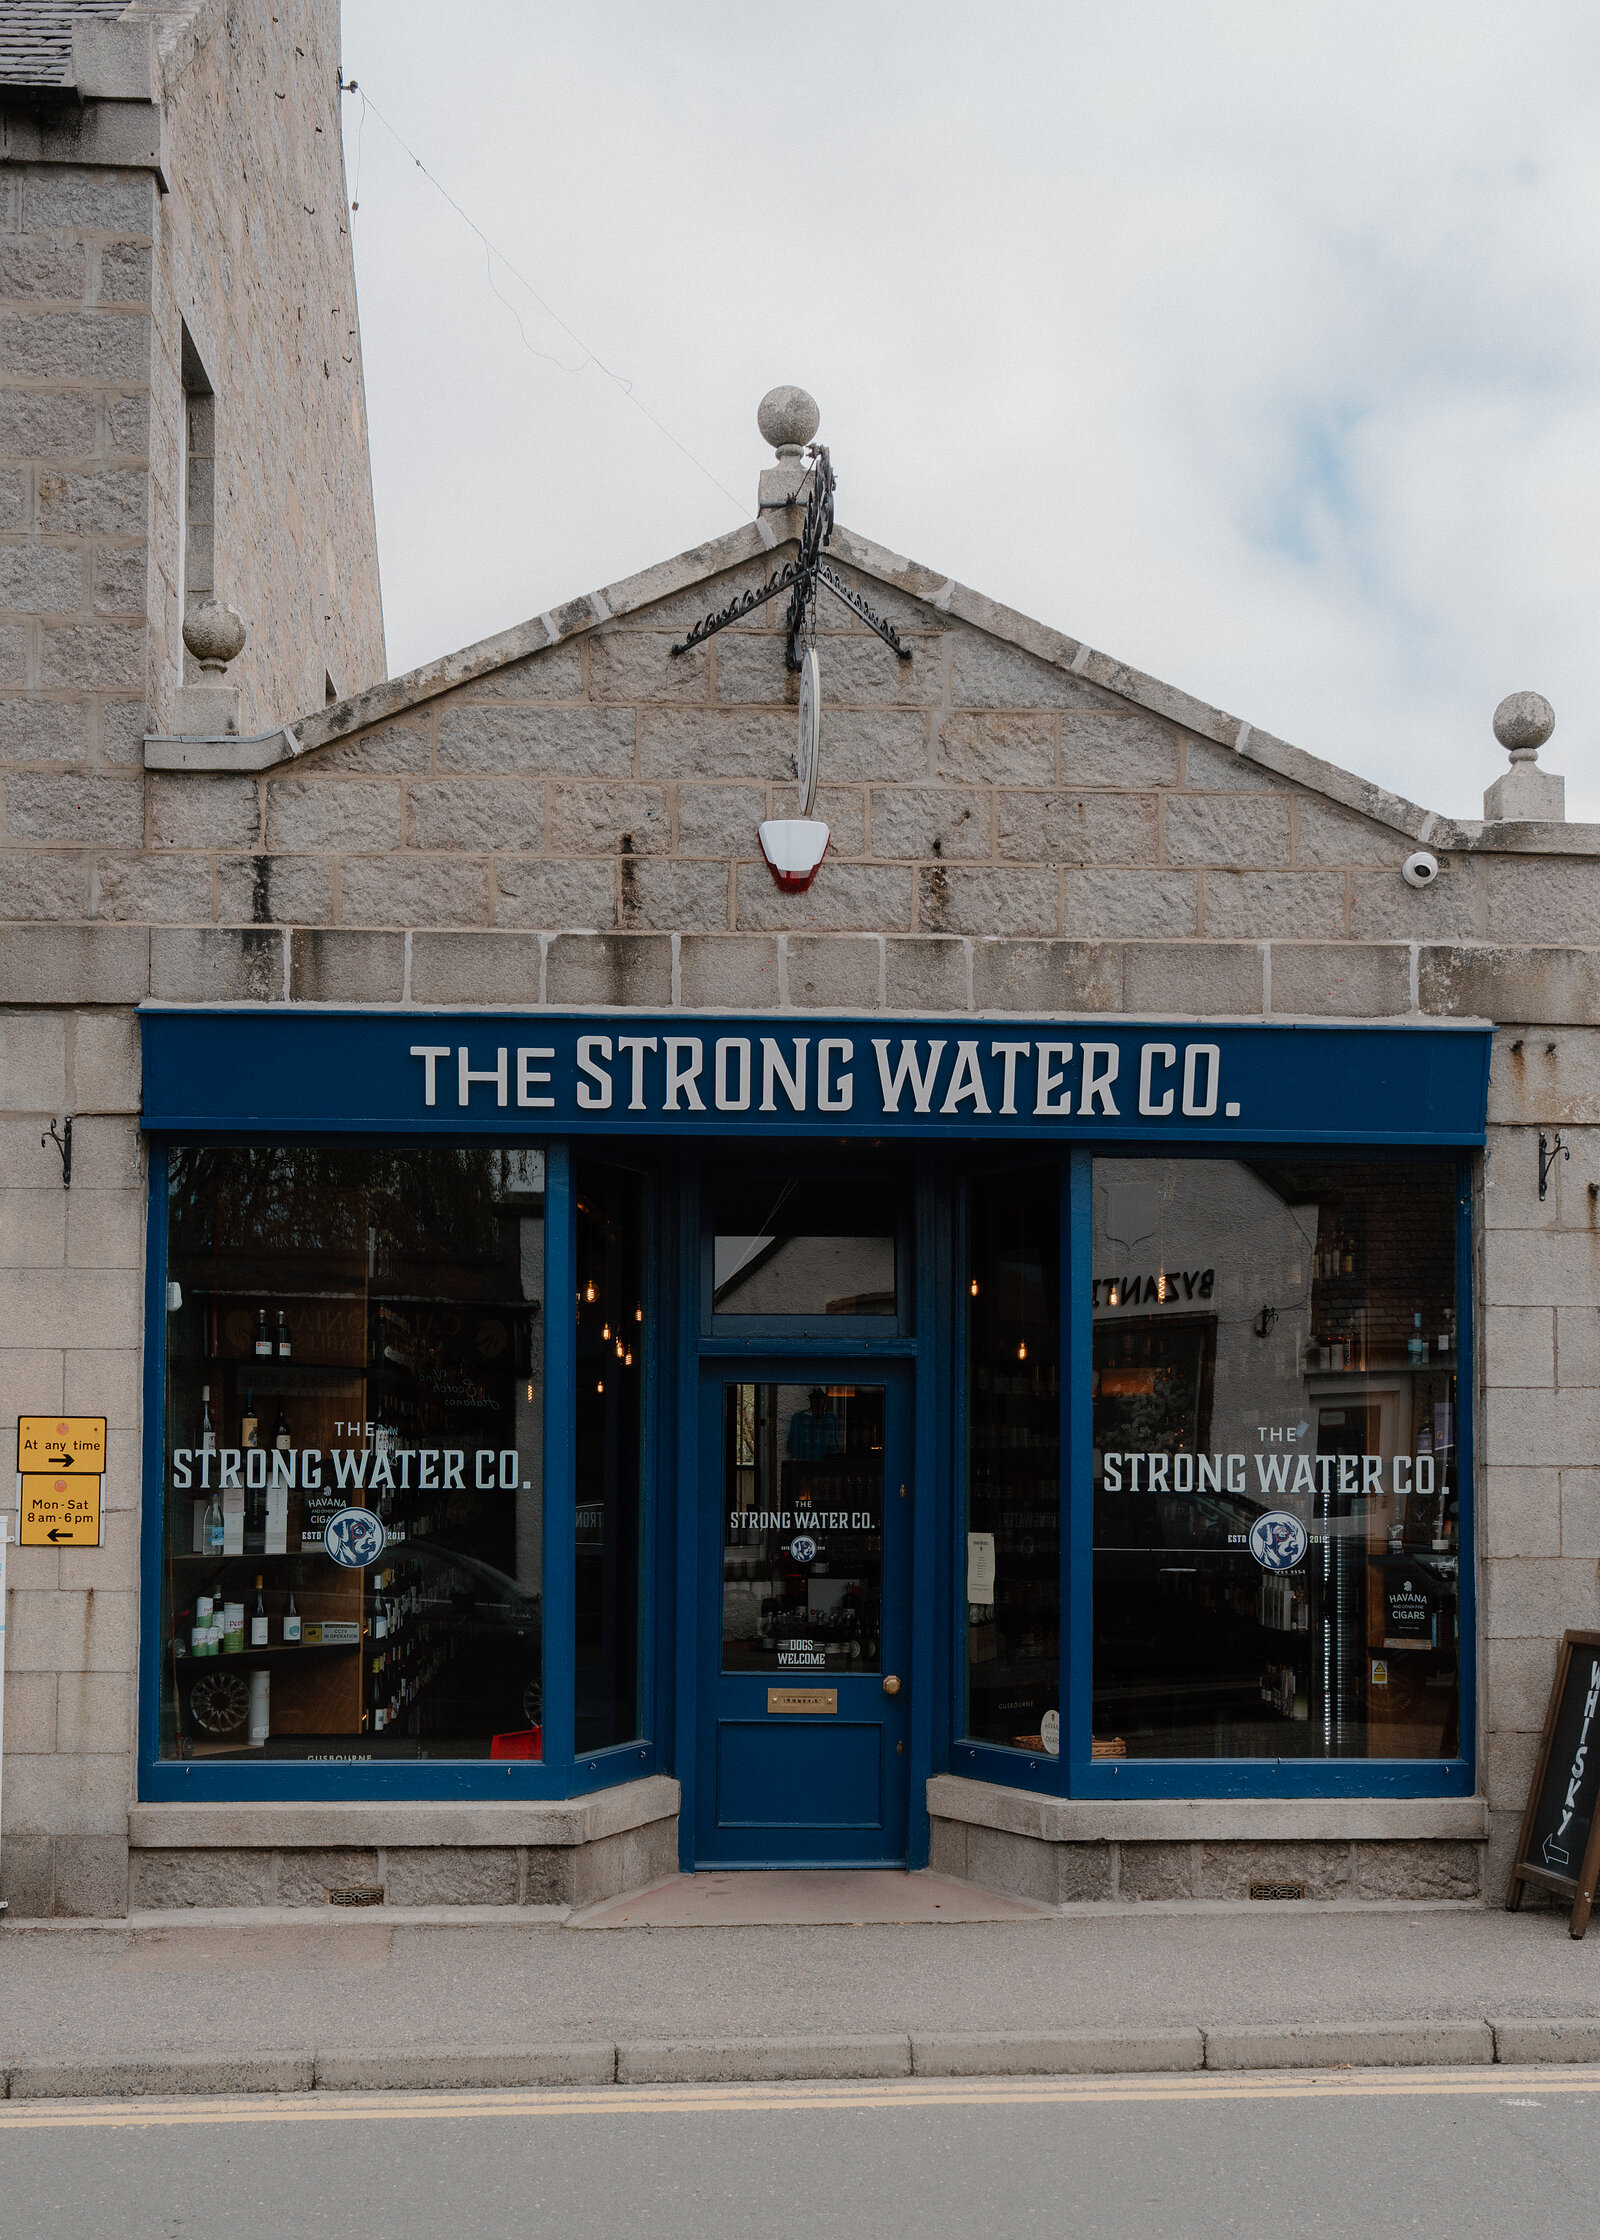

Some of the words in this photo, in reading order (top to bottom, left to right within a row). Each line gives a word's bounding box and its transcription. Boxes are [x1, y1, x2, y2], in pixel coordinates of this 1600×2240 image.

[410, 1045, 555, 1108] THE
[576, 1035, 854, 1113] STRONG
[870, 1038, 1121, 1116] WATER
[1138, 1043, 1241, 1118] CO.
[334, 1421, 376, 1437] THE
[1257, 1426, 1297, 1443] THE
[24, 1439, 38, 1450] At
[45, 1441, 66, 1453] any
[73, 1440, 101, 1451] time
[173, 1448, 322, 1490] STRONG
[331, 1449, 466, 1490] WATER
[475, 1449, 532, 1490] CO.
[1104, 1452, 1247, 1493] STRONG
[1253, 1453, 1385, 1495] WATER
[1393, 1455, 1450, 1496] CO.
[308, 1497, 347, 1509] HAVANA
[795, 1500, 813, 1508] THE
[310, 1514, 331, 1525] CIGA
[730, 1511, 791, 1529] STRONG
[794, 1511, 849, 1529] WATER
[851, 1511, 876, 1529] CO.
[301, 1531, 321, 1540] ESTD
[387, 1531, 406, 1540] 2019
[1227, 1534, 1247, 1543] ESTD
[1309, 1535, 1328, 1544] 2019
[1388, 1593, 1428, 1605] HAVANA
[1391, 1610, 1426, 1620] CIGARS
[789, 1639, 814, 1651] DOGS
[777, 1652, 826, 1665] WELCOME
